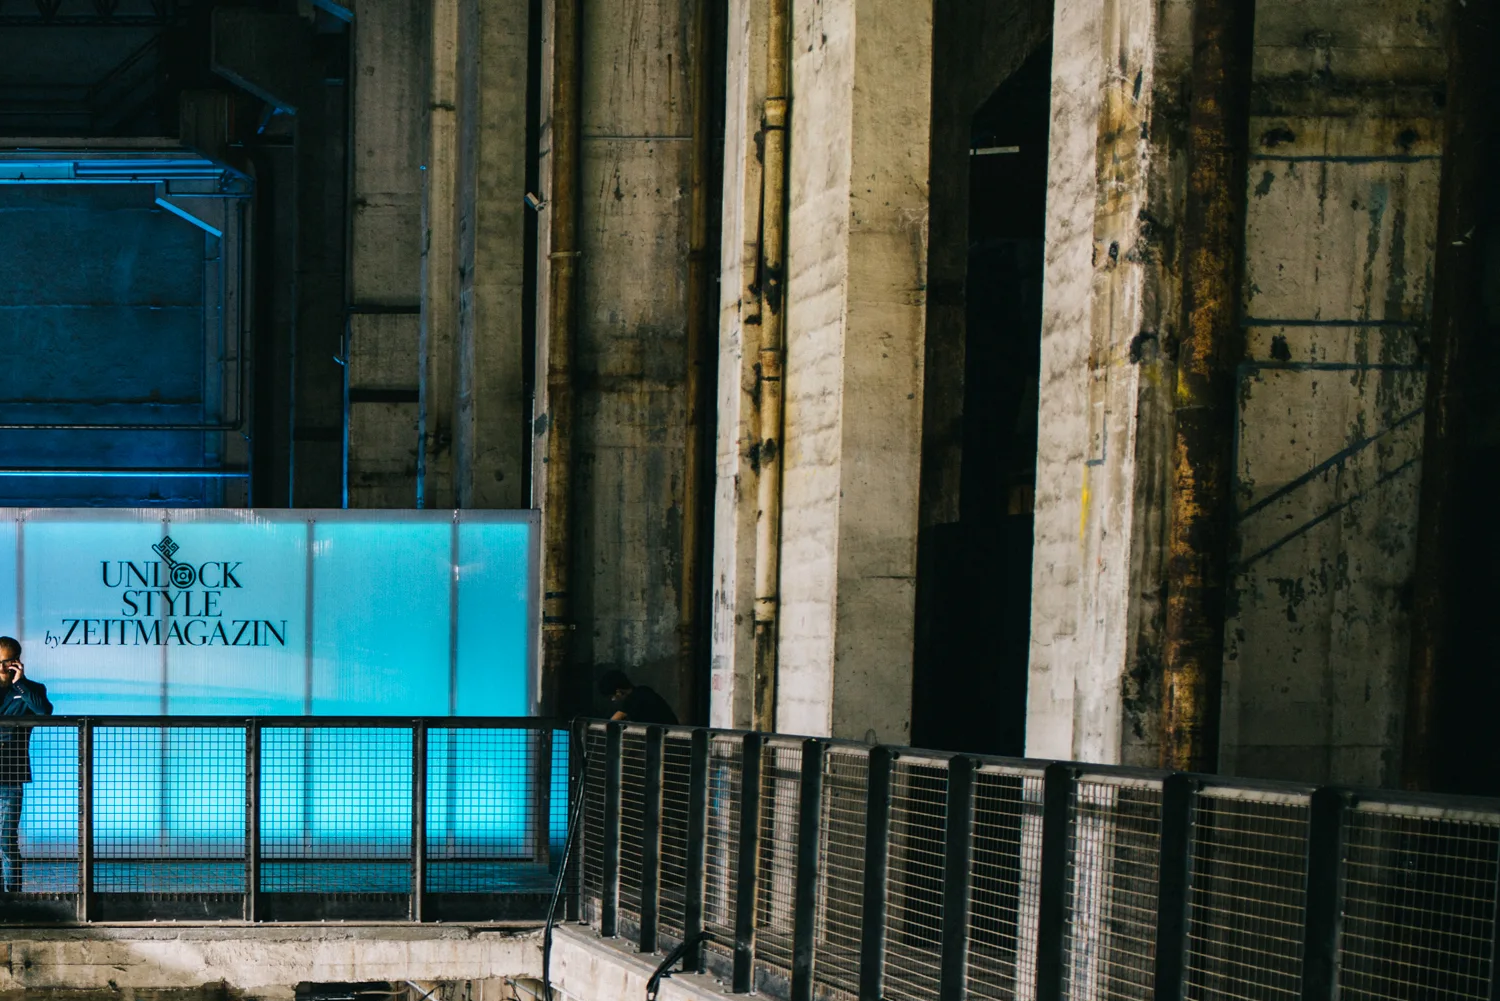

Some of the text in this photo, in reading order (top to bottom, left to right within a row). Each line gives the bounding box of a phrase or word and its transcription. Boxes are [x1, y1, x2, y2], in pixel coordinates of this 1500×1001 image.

[100, 561, 243, 589] UNLOCK
[121, 590, 223, 617] STYLE
[44, 619, 288, 649] by ZEITMAGAZIN
